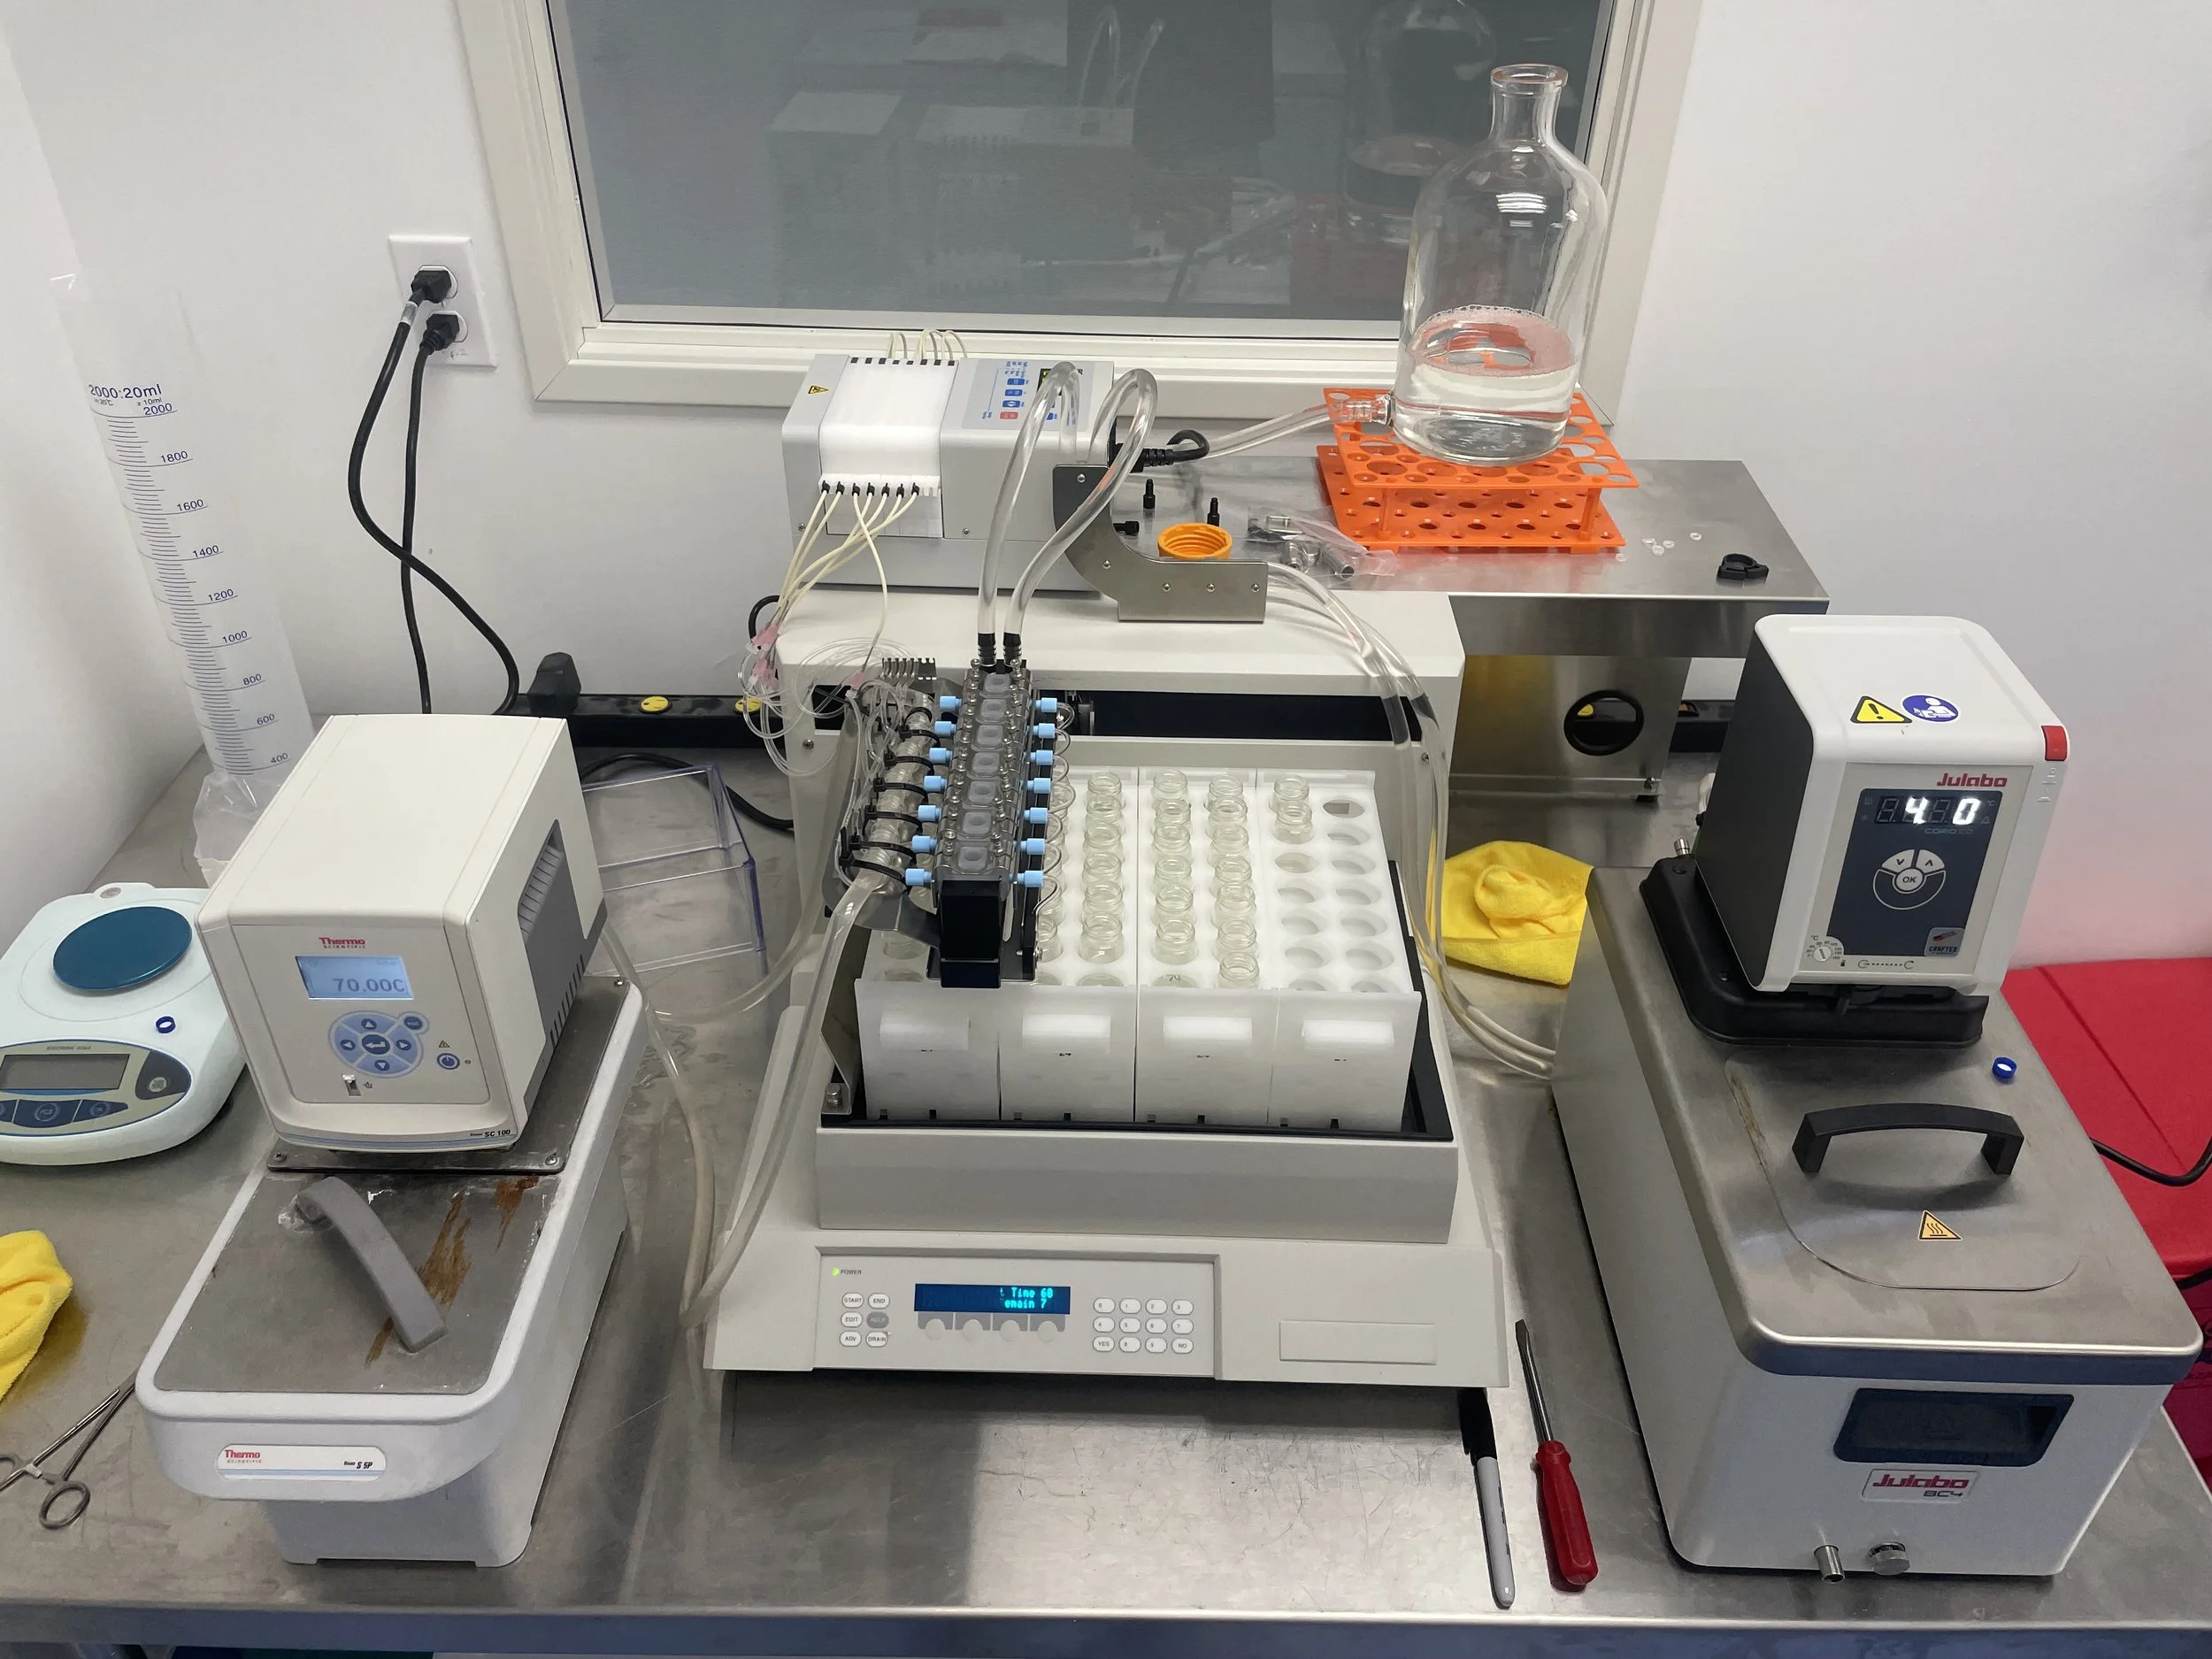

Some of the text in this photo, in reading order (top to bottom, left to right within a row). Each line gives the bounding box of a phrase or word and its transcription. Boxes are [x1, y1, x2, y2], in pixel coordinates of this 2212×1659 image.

[143, 403, 173, 416] 2000
[161, 450, 188, 464] 1800
[177, 498, 204, 512] 1600
[193, 544, 219, 558] 1400
[208, 588, 234, 602] 1200
[222, 630, 248, 644] 1000
[242, 673, 262, 686] 800
[257, 713, 275, 726] 600
[270, 752, 288, 764] 400
[333, 978, 405, 993] 70.00C
[1010, 1286, 1036, 1298] Time
[1041, 1287, 1054, 1299] 60
[1041, 1298, 1048, 1309] 7
[225, 1449, 261, 1459] Thermo
[356, 1461, 363, 1470] S
